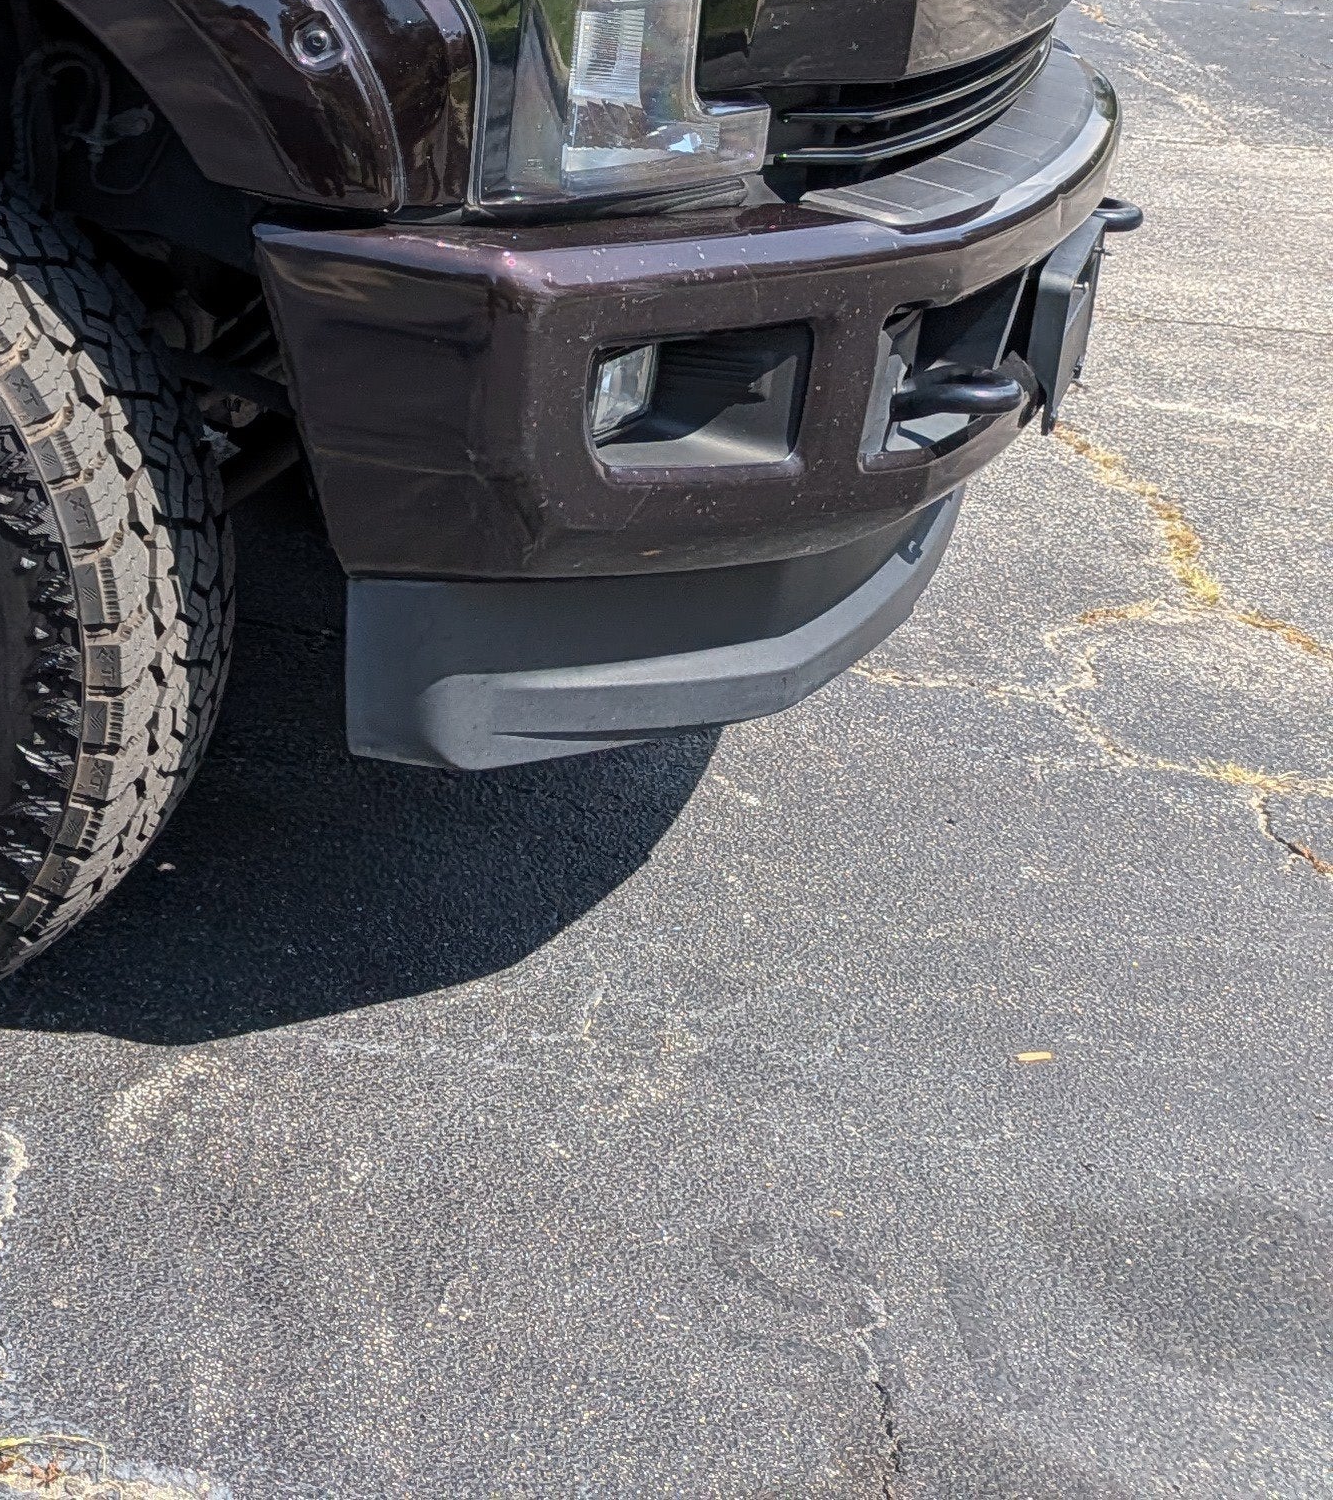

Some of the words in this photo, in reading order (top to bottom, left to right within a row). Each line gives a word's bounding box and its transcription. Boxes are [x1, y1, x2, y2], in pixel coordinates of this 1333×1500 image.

[12, 377, 40, 407] XT
[70, 497, 91, 528] XT
[97, 647, 115, 681] XT
[89, 758, 107, 793] XT
[52, 860, 73, 886] XT
